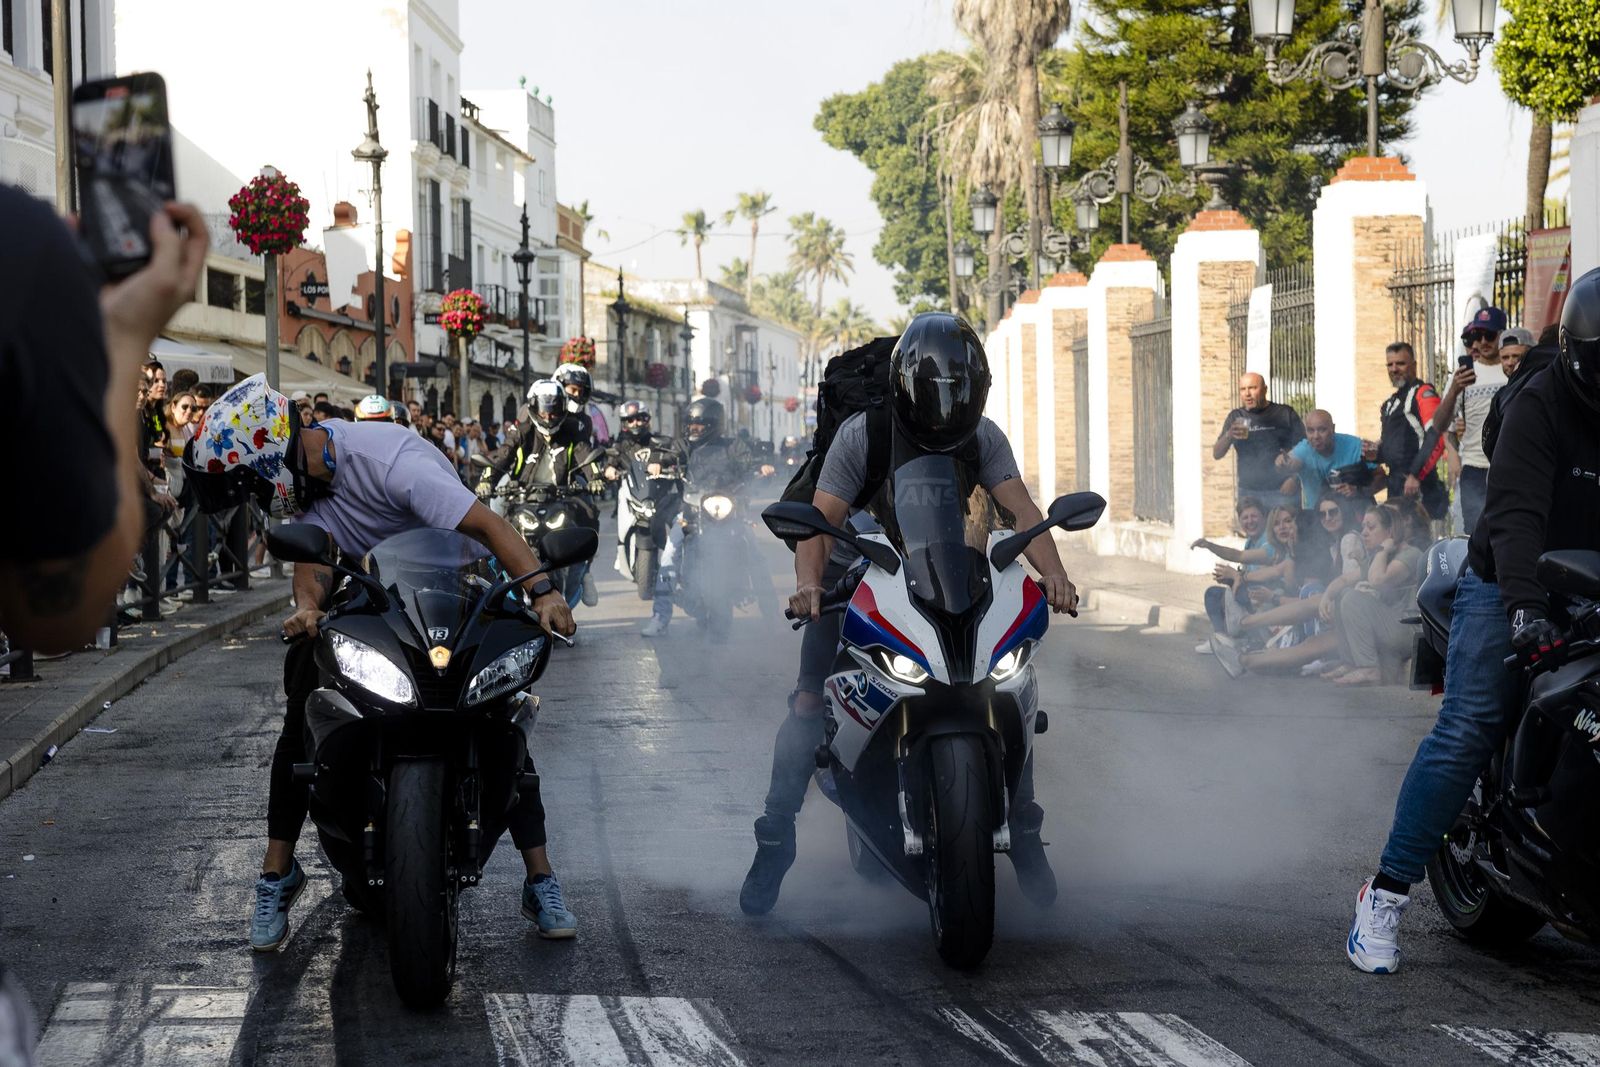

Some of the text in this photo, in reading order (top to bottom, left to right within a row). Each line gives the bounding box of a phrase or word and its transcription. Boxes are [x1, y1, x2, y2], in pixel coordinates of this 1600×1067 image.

[303, 285, 316, 294] LOS
[433, 630, 446, 640] 13
[869, 676, 899, 699] S1000
